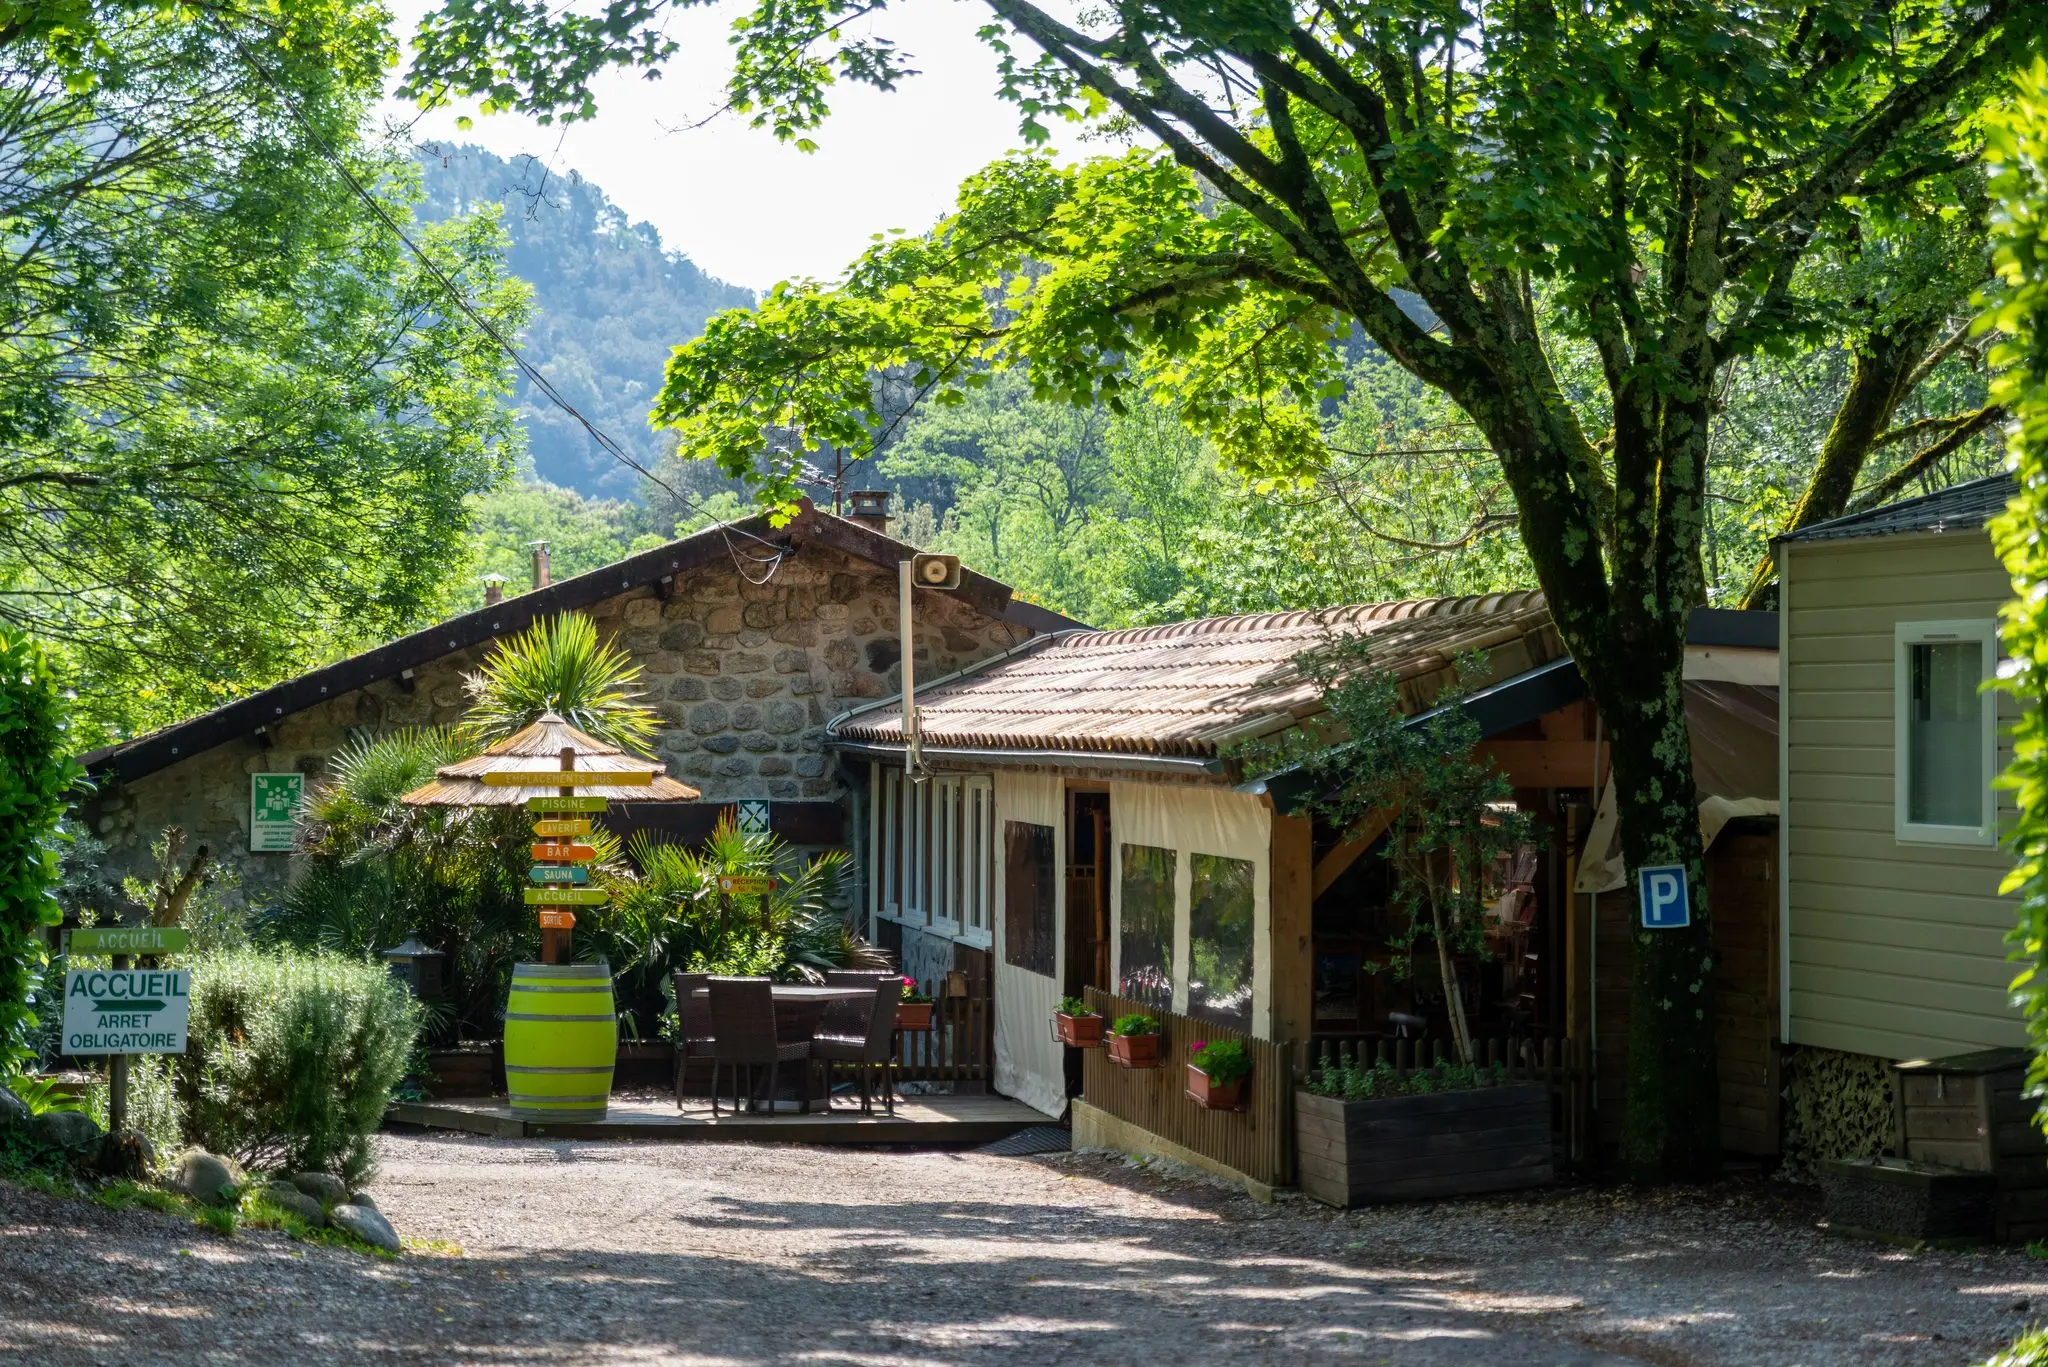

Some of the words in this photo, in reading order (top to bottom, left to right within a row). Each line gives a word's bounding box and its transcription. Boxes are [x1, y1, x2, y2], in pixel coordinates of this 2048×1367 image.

[505, 773, 585, 784] EMPLACEMENTS
[592, 773, 613, 784] NUS
[542, 799, 586, 809] PISCINE
[541, 823, 580, 833] LAVERIE
[546, 846, 570, 857] BAR
[543, 870, 573, 880] SAUNA
[537, 891, 584, 902] ACCUEIL
[1650, 873, 1678, 921] P
[543, 914, 563, 925] SORTIE
[70, 973, 187, 998] ACCUEIL
[97, 1014, 152, 1029] ARRET
[69, 1033, 177, 1049] OBLIGATOIRE
